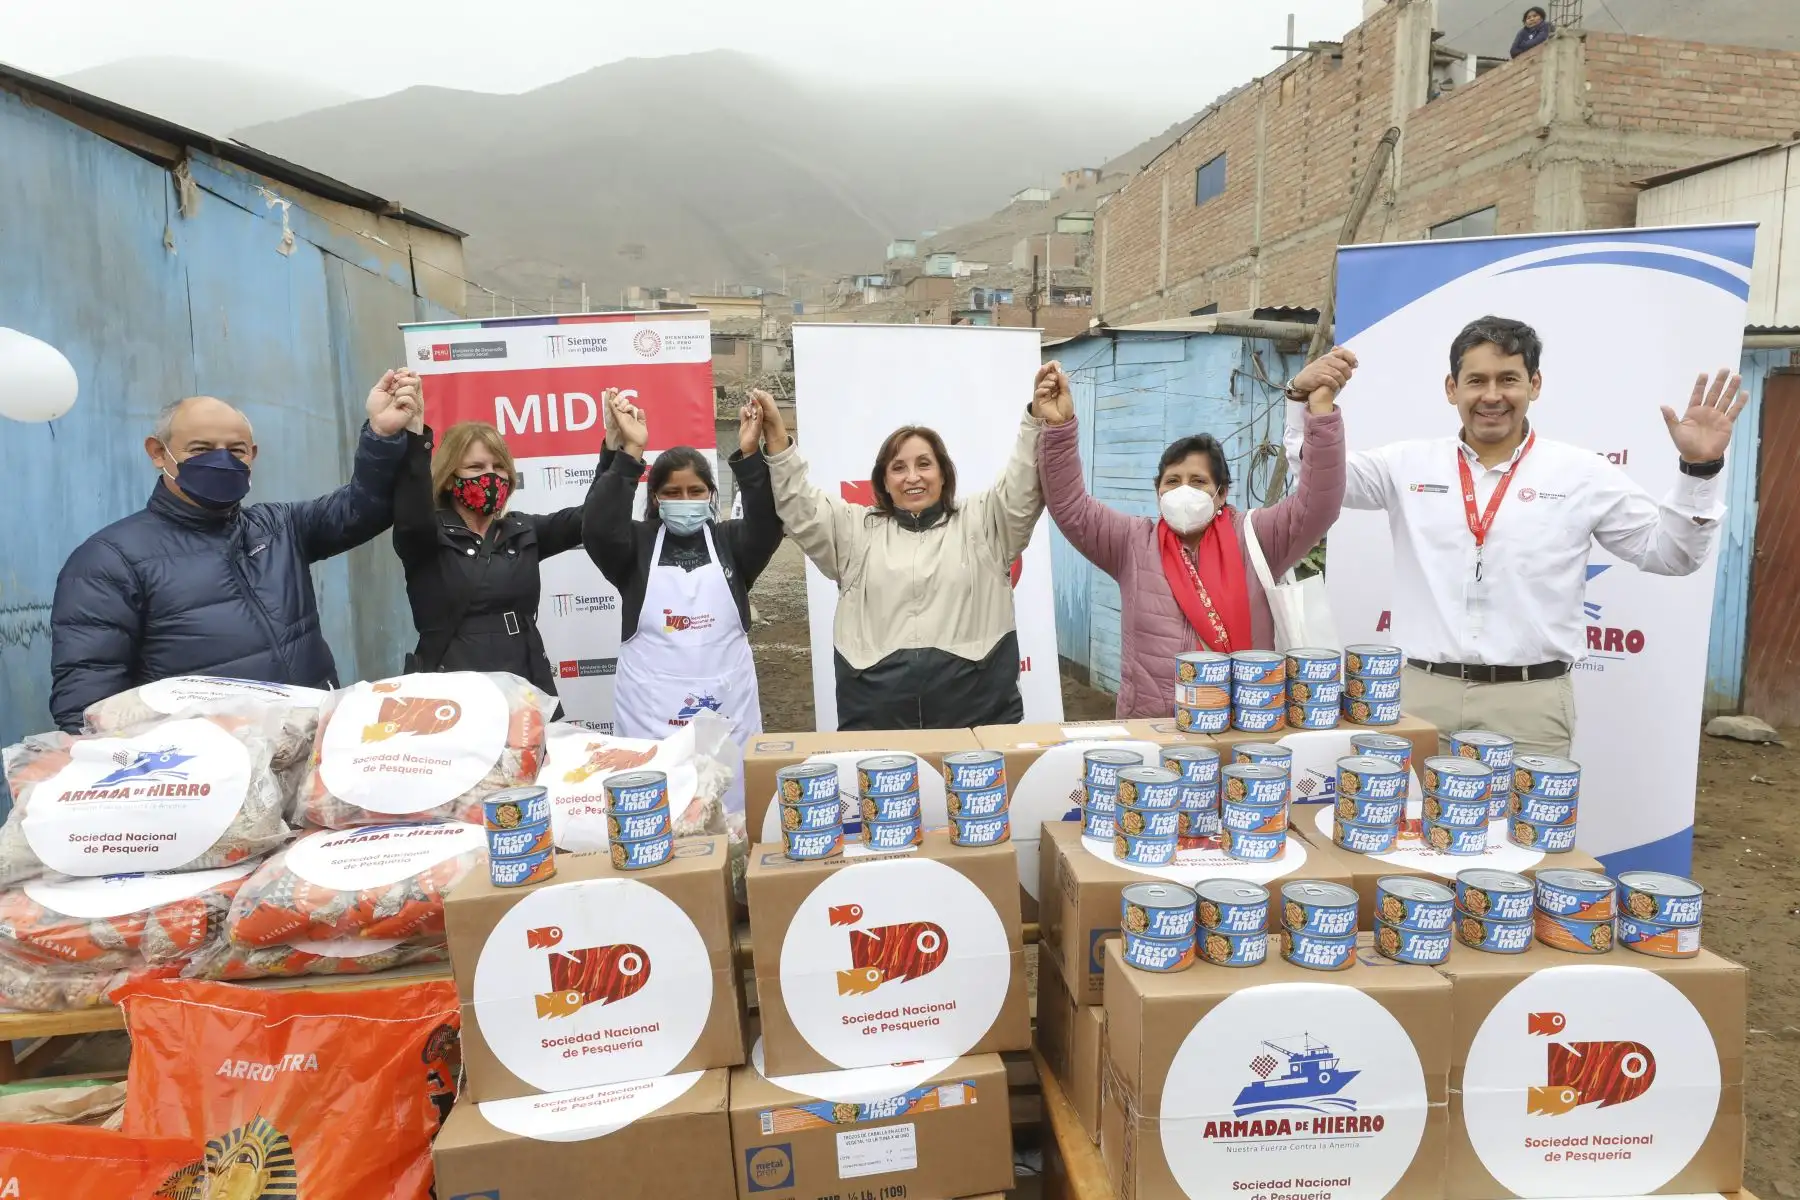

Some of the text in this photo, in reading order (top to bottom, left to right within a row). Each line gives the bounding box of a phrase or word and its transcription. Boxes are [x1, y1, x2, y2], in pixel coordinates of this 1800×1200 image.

[568, 337, 607, 348] Siempre
[582, 345, 608, 354] pueblo
[565, 469, 596, 479] Siemp
[579, 478, 595, 486] pue
[576, 595, 614, 605] Siempre
[590, 603, 615, 612] pueblo
[1586, 626, 1645, 654] RRO
[1233, 663, 1262, 675] fresco
[1303, 661, 1336, 676] fresco
[1366, 657, 1398, 672] fresco
[1372, 666, 1393, 675] mar
[1574, 662, 1604, 672] emia
[1200, 664, 1229, 678] fresco
[1235, 672, 1253, 681] mar
[1308, 669, 1330, 679] mar
[1206, 673, 1224, 682] mar
[1235, 687, 1270, 701] fresco
[1240, 696, 1260, 706] mar
[586, 722, 614, 730] Siemp
[353, 754, 451, 766] Sociedad Nacional
[363, 764, 376, 772] de
[875, 770, 911, 788] fresco
[957, 766, 994, 784] fresco
[880, 781, 906, 791] mar
[962, 776, 987, 787] mar
[1365, 776, 1400, 792] fresco
[1443, 776, 1484, 794] fresco
[1536, 775, 1577, 793] fresco
[56, 787, 130, 802] ARMADA
[147, 783, 210, 796] HIERRO
[1142, 786, 1177, 801] fresco
[1251, 781, 1286, 796] fresco
[1371, 787, 1396, 797] mar
[1449, 787, 1476, 798] mar
[1544, 786, 1568, 796] mar
[556, 794, 602, 805] Sociedad
[619, 789, 657, 805] fresco
[1148, 797, 1171, 808] mar
[1257, 792, 1281, 802] mar
[568, 807, 581, 815] de
[625, 800, 650, 811] mar
[1525, 801, 1568, 818] fresco
[1532, 813, 1560, 823] mar
[875, 825, 912, 842] fresco
[964, 821, 1000, 839] fresco
[69, 832, 177, 842] Sociedad Nacional
[320, 833, 390, 848] ARMADA
[407, 828, 464, 837] HIERRO
[493, 832, 531, 850] fresco
[881, 835, 906, 846] mar
[969, 831, 994, 842] mar
[1348, 828, 1388, 847] fresco
[84, 845, 98, 853] de
[498, 842, 524, 854] mar
[632, 840, 668, 858] fresco
[794, 835, 831, 851] fresco
[1133, 841, 1172, 857] fresco
[1236, 837, 1276, 854] fresco
[1353, 840, 1380, 850] mar
[799, 845, 823, 855] mar
[1241, 848, 1270, 857] mar
[639, 851, 663, 864] mar
[1139, 852, 1165, 862] mar
[492, 859, 527, 875] fresco
[497, 871, 519, 882] mar
[1537, 883, 1576, 906] fresco
[1540, 899, 1565, 911] mar
[1226, 905, 1265, 923] fresco
[1410, 904, 1451, 922] fresco
[1233, 919, 1261, 930] mar
[1418, 918, 1444, 930] mar
[260, 921, 300, 942] PAISANA
[31, 936, 77, 958] AISANA
[1132, 939, 1176, 960] fresco
[1299, 937, 1345, 957] fresco
[1136, 955, 1167, 967] mar
[1305, 954, 1336, 964] mar
[842, 1000, 956, 1025] Sociedad Nacional
[862, 1015, 940, 1035] de Pesquería
[541, 1022, 660, 1048] Sociedad Nacional
[562, 1038, 643, 1058] de Pesquería
[281, 1053, 319, 1072] TRA
[534, 1082, 654, 1110] Sociedad Nacional
[551, 1105, 567, 1113] de
[864, 1096, 905, 1114] fresco
[870, 1106, 897, 1120] mar
[1203, 1115, 1385, 1138] ARMADA DE HIERRO
[1227, 1145, 1258, 1153] Nuestra
[1260, 1144, 1287, 1152] Fuerza
[1290, 1142, 1317, 1150] Contra
[1329, 1141, 1359, 1149] Anemia
[1525, 1134, 1653, 1148] Sociedad Nacional
[1544, 1148, 1632, 1163] de Pesquería
[756, 1159, 783, 1170] metal
[1232, 1177, 1351, 1190] Sociedad Nacional
[880, 1185, 907, 1200] (109)
[1251, 1191, 1331, 1200] de Pesquería
